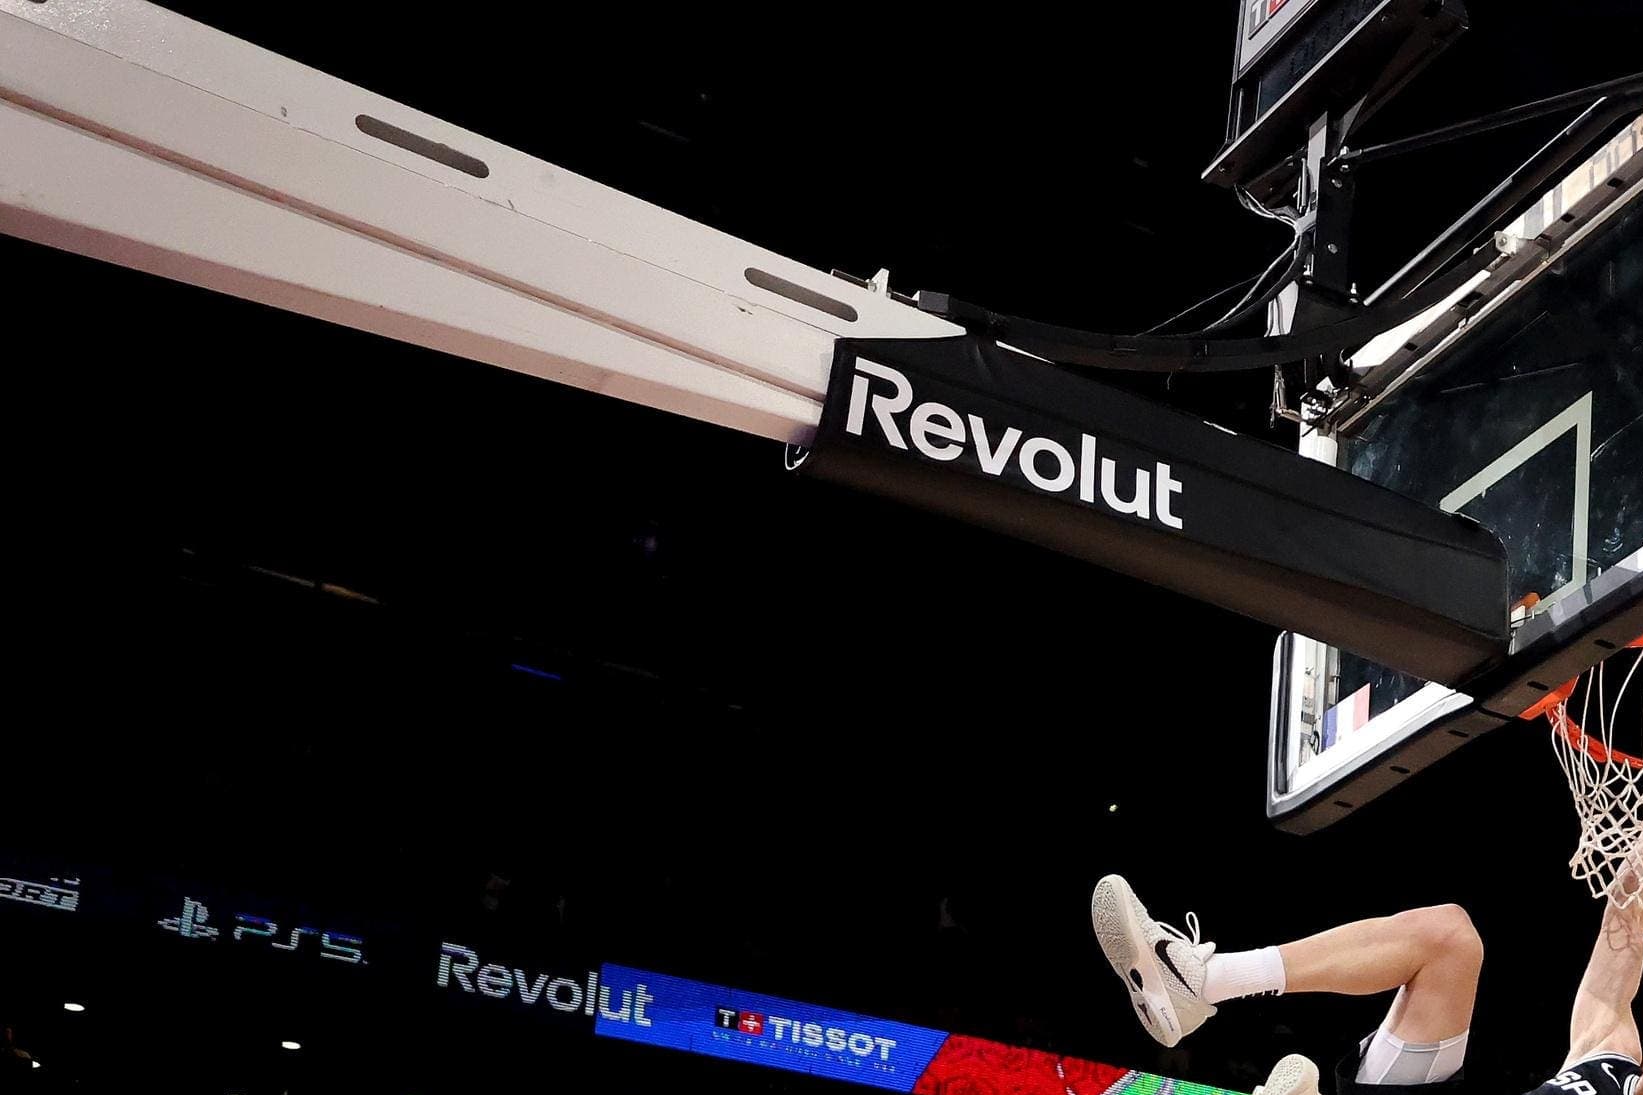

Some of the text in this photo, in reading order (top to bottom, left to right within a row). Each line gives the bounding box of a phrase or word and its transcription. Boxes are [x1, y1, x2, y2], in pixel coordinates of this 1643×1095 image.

[846, 356, 1183, 530] Revolut
[436, 942, 653, 1027] Revolut
[768, 1015, 896, 1061] TISSOT
